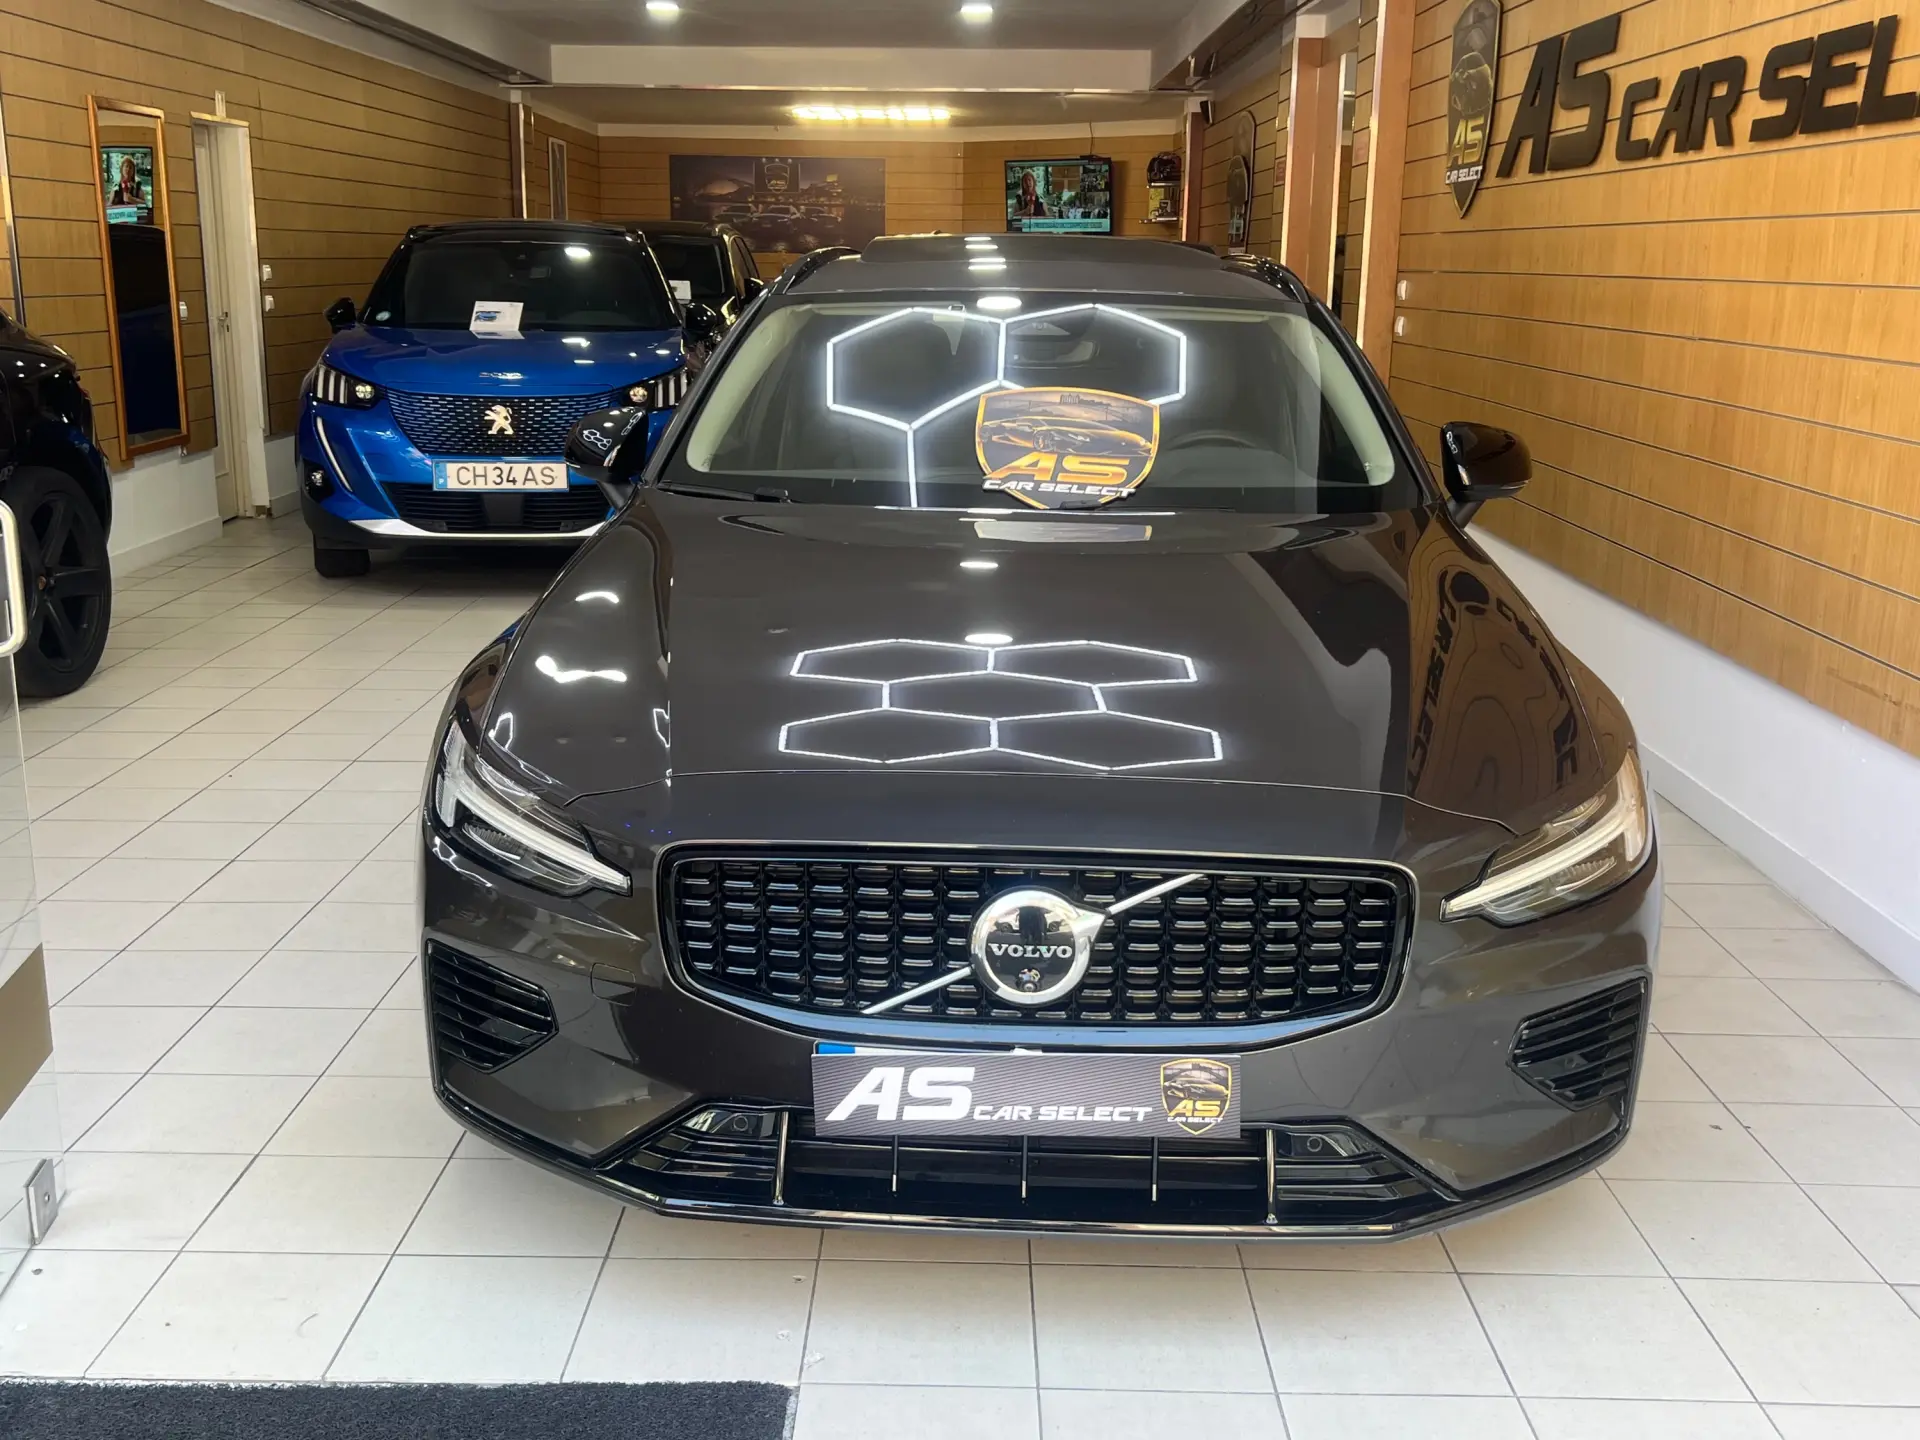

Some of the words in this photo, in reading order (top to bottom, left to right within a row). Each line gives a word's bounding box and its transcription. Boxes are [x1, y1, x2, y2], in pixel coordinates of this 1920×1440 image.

[1496, 14, 1621, 178] AS
[1615, 56, 1747, 161] CAR
[1749, 15, 1920, 142] SEL
[1448, 116, 1484, 168] AS
[1445, 170, 1458, 184] CAR
[1458, 165, 1483, 182] SELECT
[984, 451, 1130, 486] AS
[982, 479, 1034, 492] CAR
[1038, 482, 1136, 498] SELECT
[988, 943, 1073, 959] VOLVO
[825, 1067, 975, 1121] AS
[973, 1107, 1033, 1122] CAR
[1038, 1106, 1153, 1123] SELECT
[1168, 1099, 1222, 1117] AS
